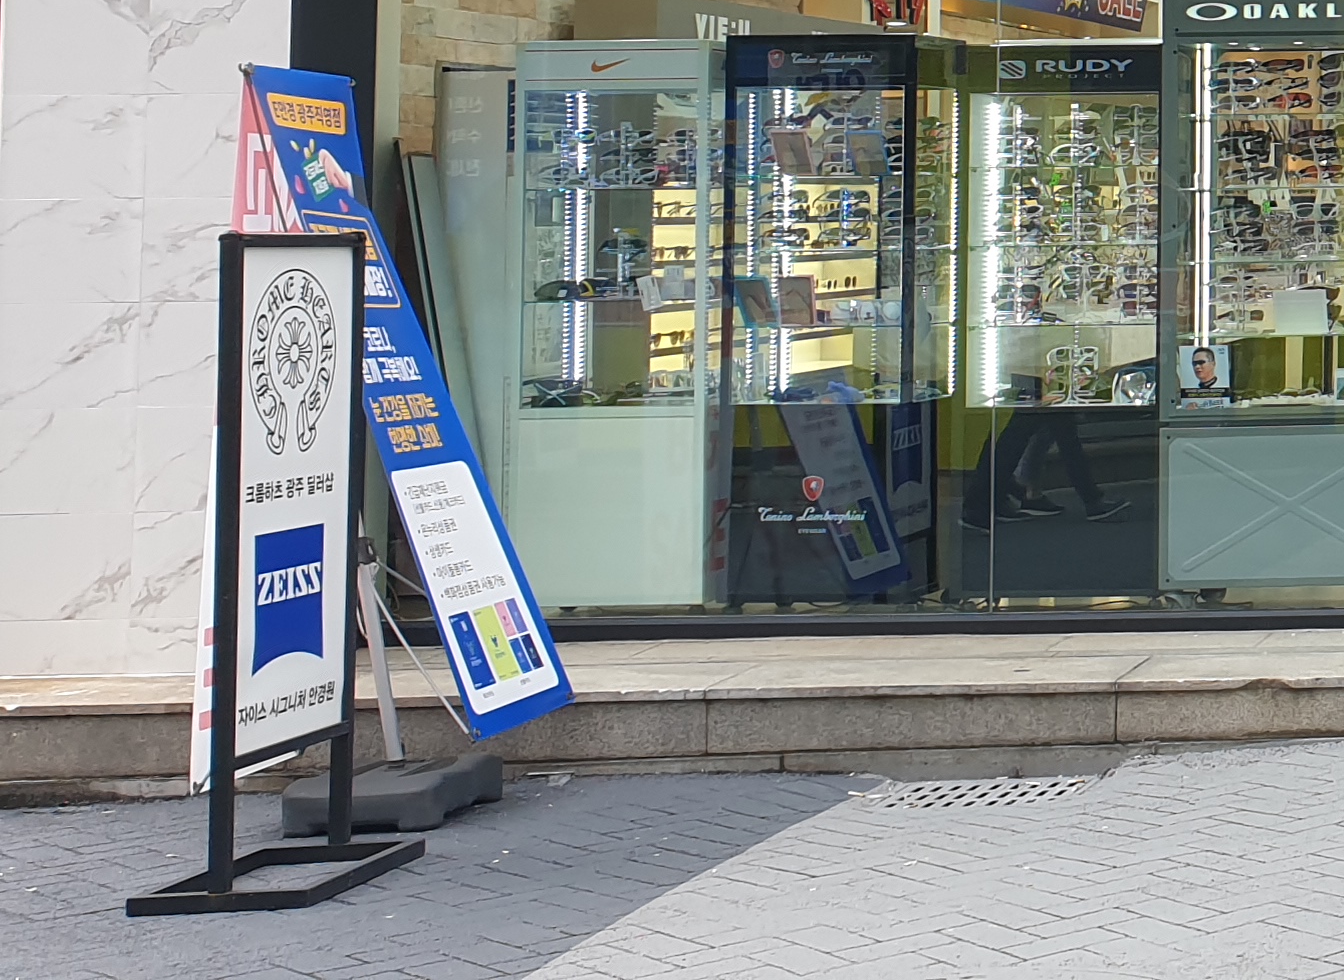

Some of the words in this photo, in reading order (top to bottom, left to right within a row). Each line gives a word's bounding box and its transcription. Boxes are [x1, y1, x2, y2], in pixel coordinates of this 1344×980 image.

[1036, 59, 1134, 73] RUDY
[245, 482, 284, 504] 크롬하츠
[285, 477, 304, 500] 광주
[307, 472, 334, 496] 딜러샵
[758, 506, 793, 522] Tonino
[796, 506, 868, 524] Lamborghini
[257, 561, 323, 606] ZEISS
[238, 702, 268, 727] 자이스
[269, 688, 307, 718] 시그니처
[308, 680, 336, 707] 안경원
